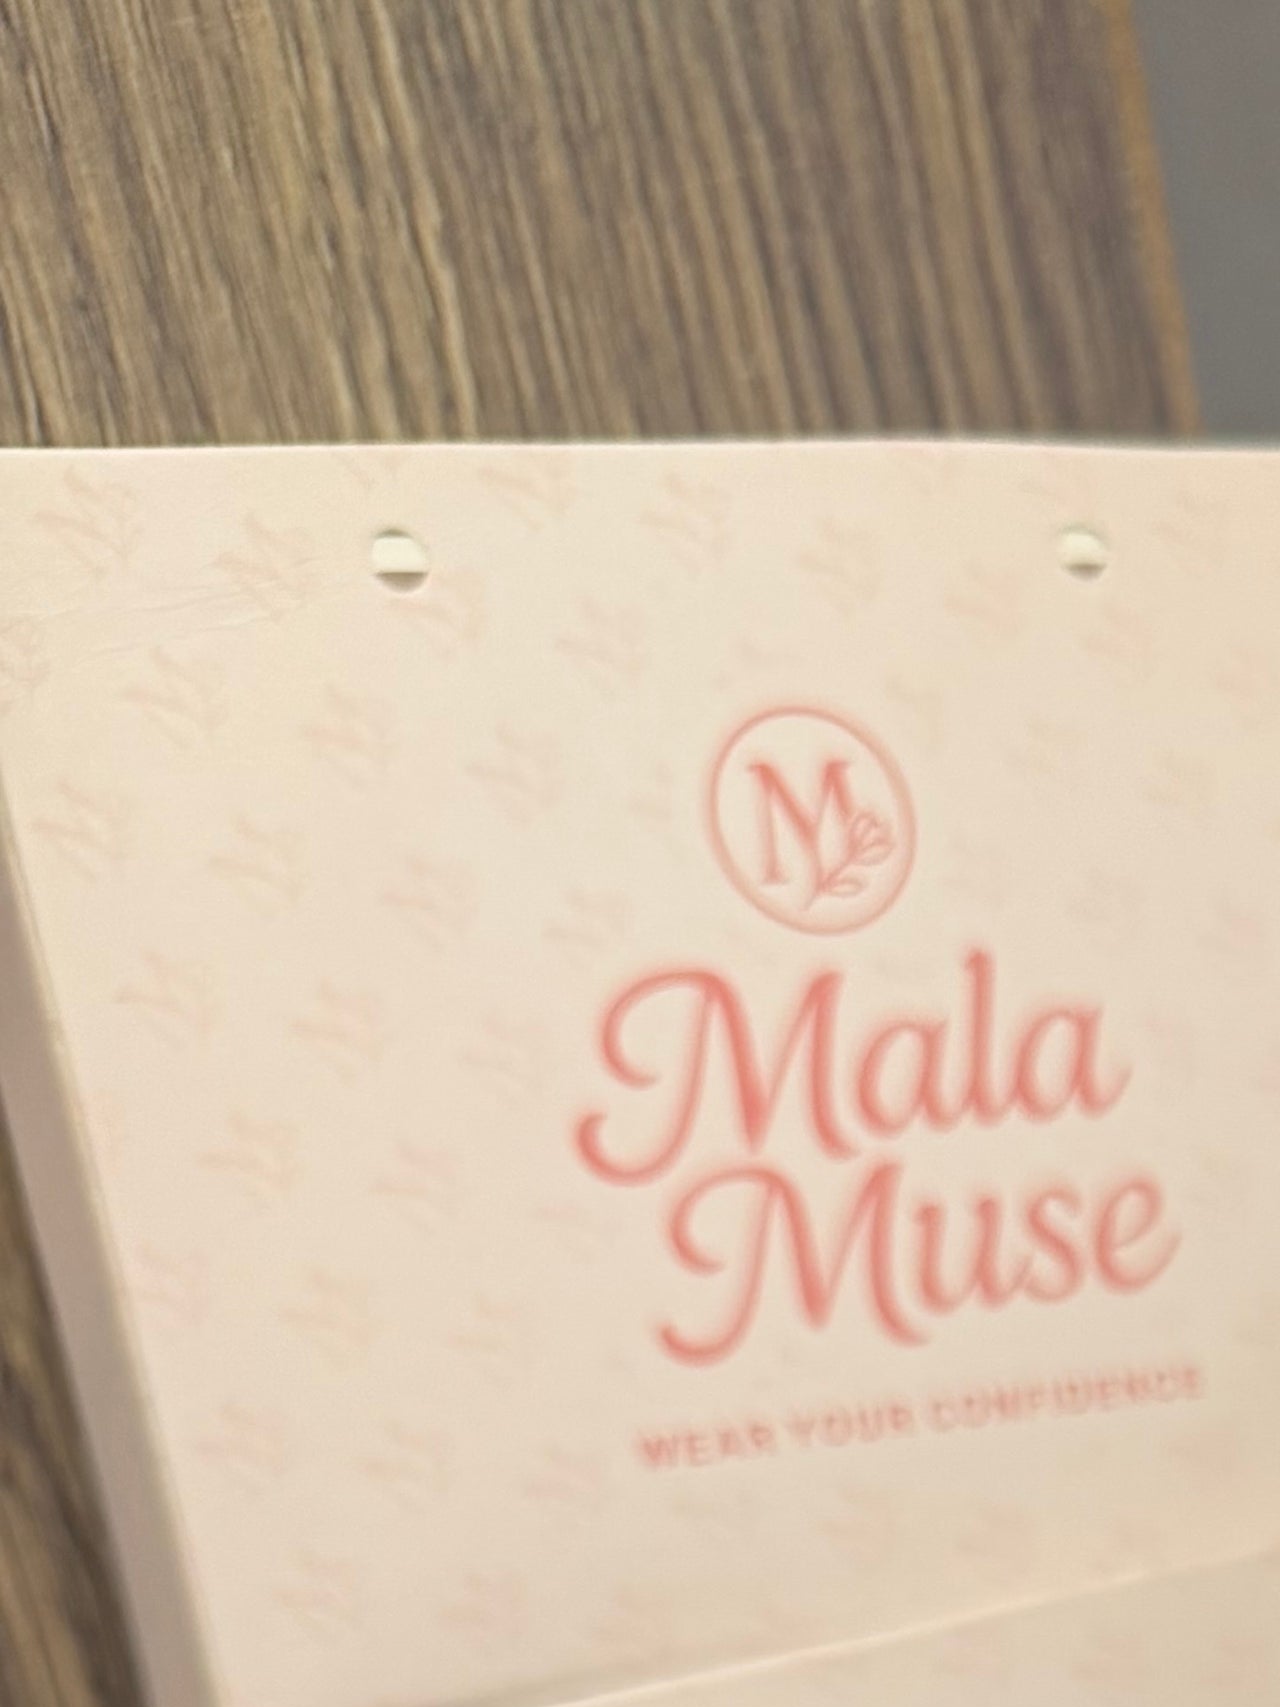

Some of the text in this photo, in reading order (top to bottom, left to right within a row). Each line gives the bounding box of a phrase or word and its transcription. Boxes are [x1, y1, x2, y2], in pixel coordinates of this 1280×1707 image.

[573, 945, 1132, 1188] Mala
[655, 1160, 1183, 1369] Muse
[638, 1362, 1205, 1469] WEAR YOUR CONFIDENCE
